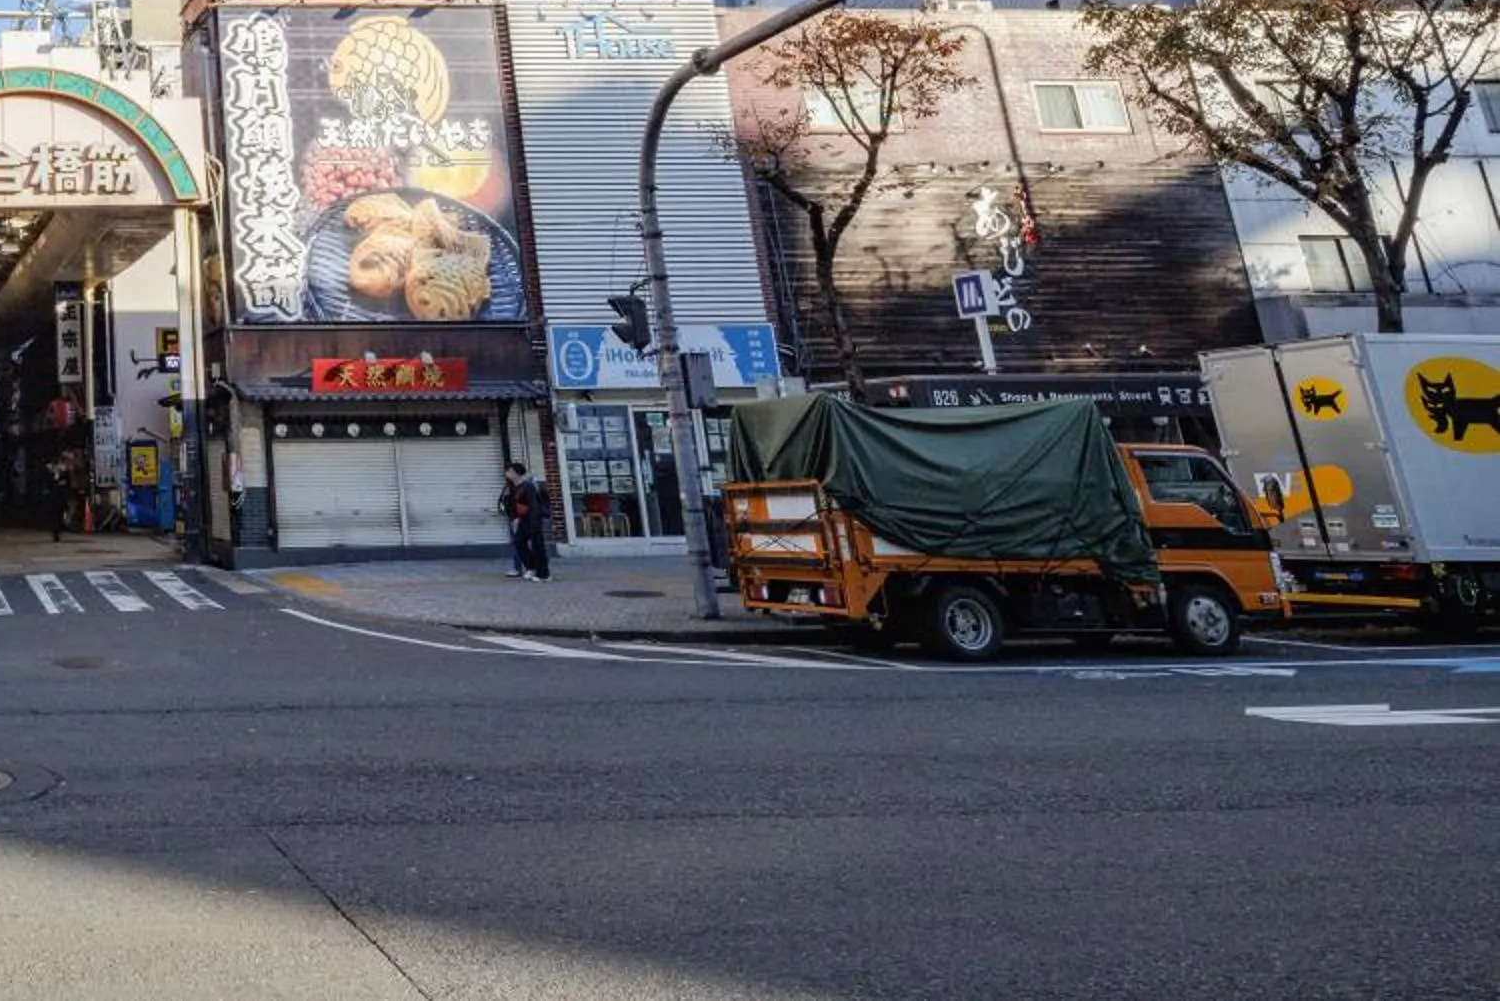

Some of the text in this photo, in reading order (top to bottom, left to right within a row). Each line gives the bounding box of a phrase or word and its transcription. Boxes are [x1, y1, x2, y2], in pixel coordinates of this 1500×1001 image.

[227, 14, 307, 317] 鳴門鯛焼本舗
[318, 118, 493, 151] 天然たいやき
